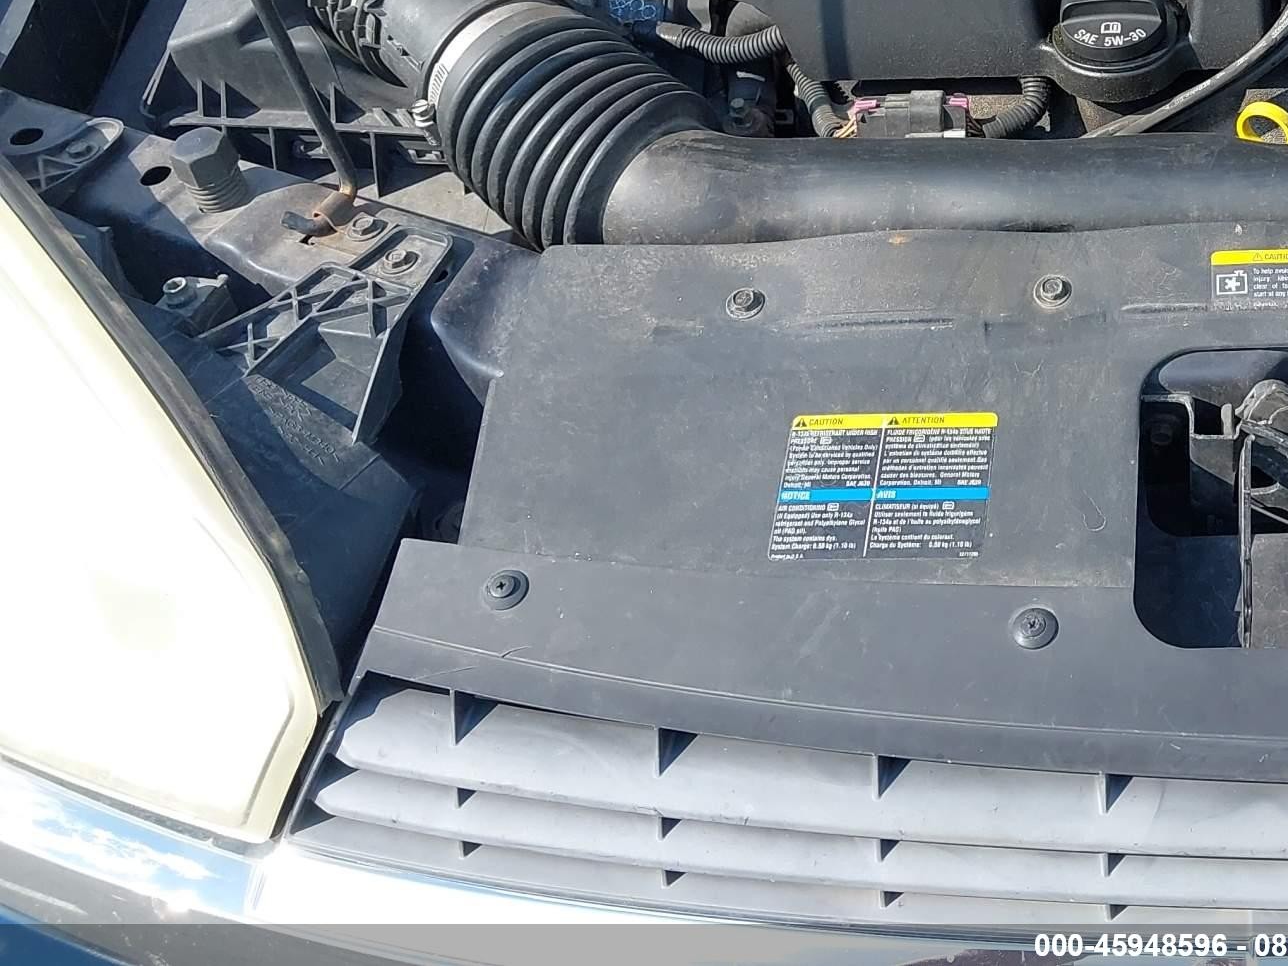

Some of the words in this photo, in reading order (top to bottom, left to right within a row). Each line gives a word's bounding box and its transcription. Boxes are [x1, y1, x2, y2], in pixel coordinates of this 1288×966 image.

[1074, 29, 1099, 45] SAE
[1104, 28, 1146, 46] 5W-30
[876, 490, 896, 499] AVIS
